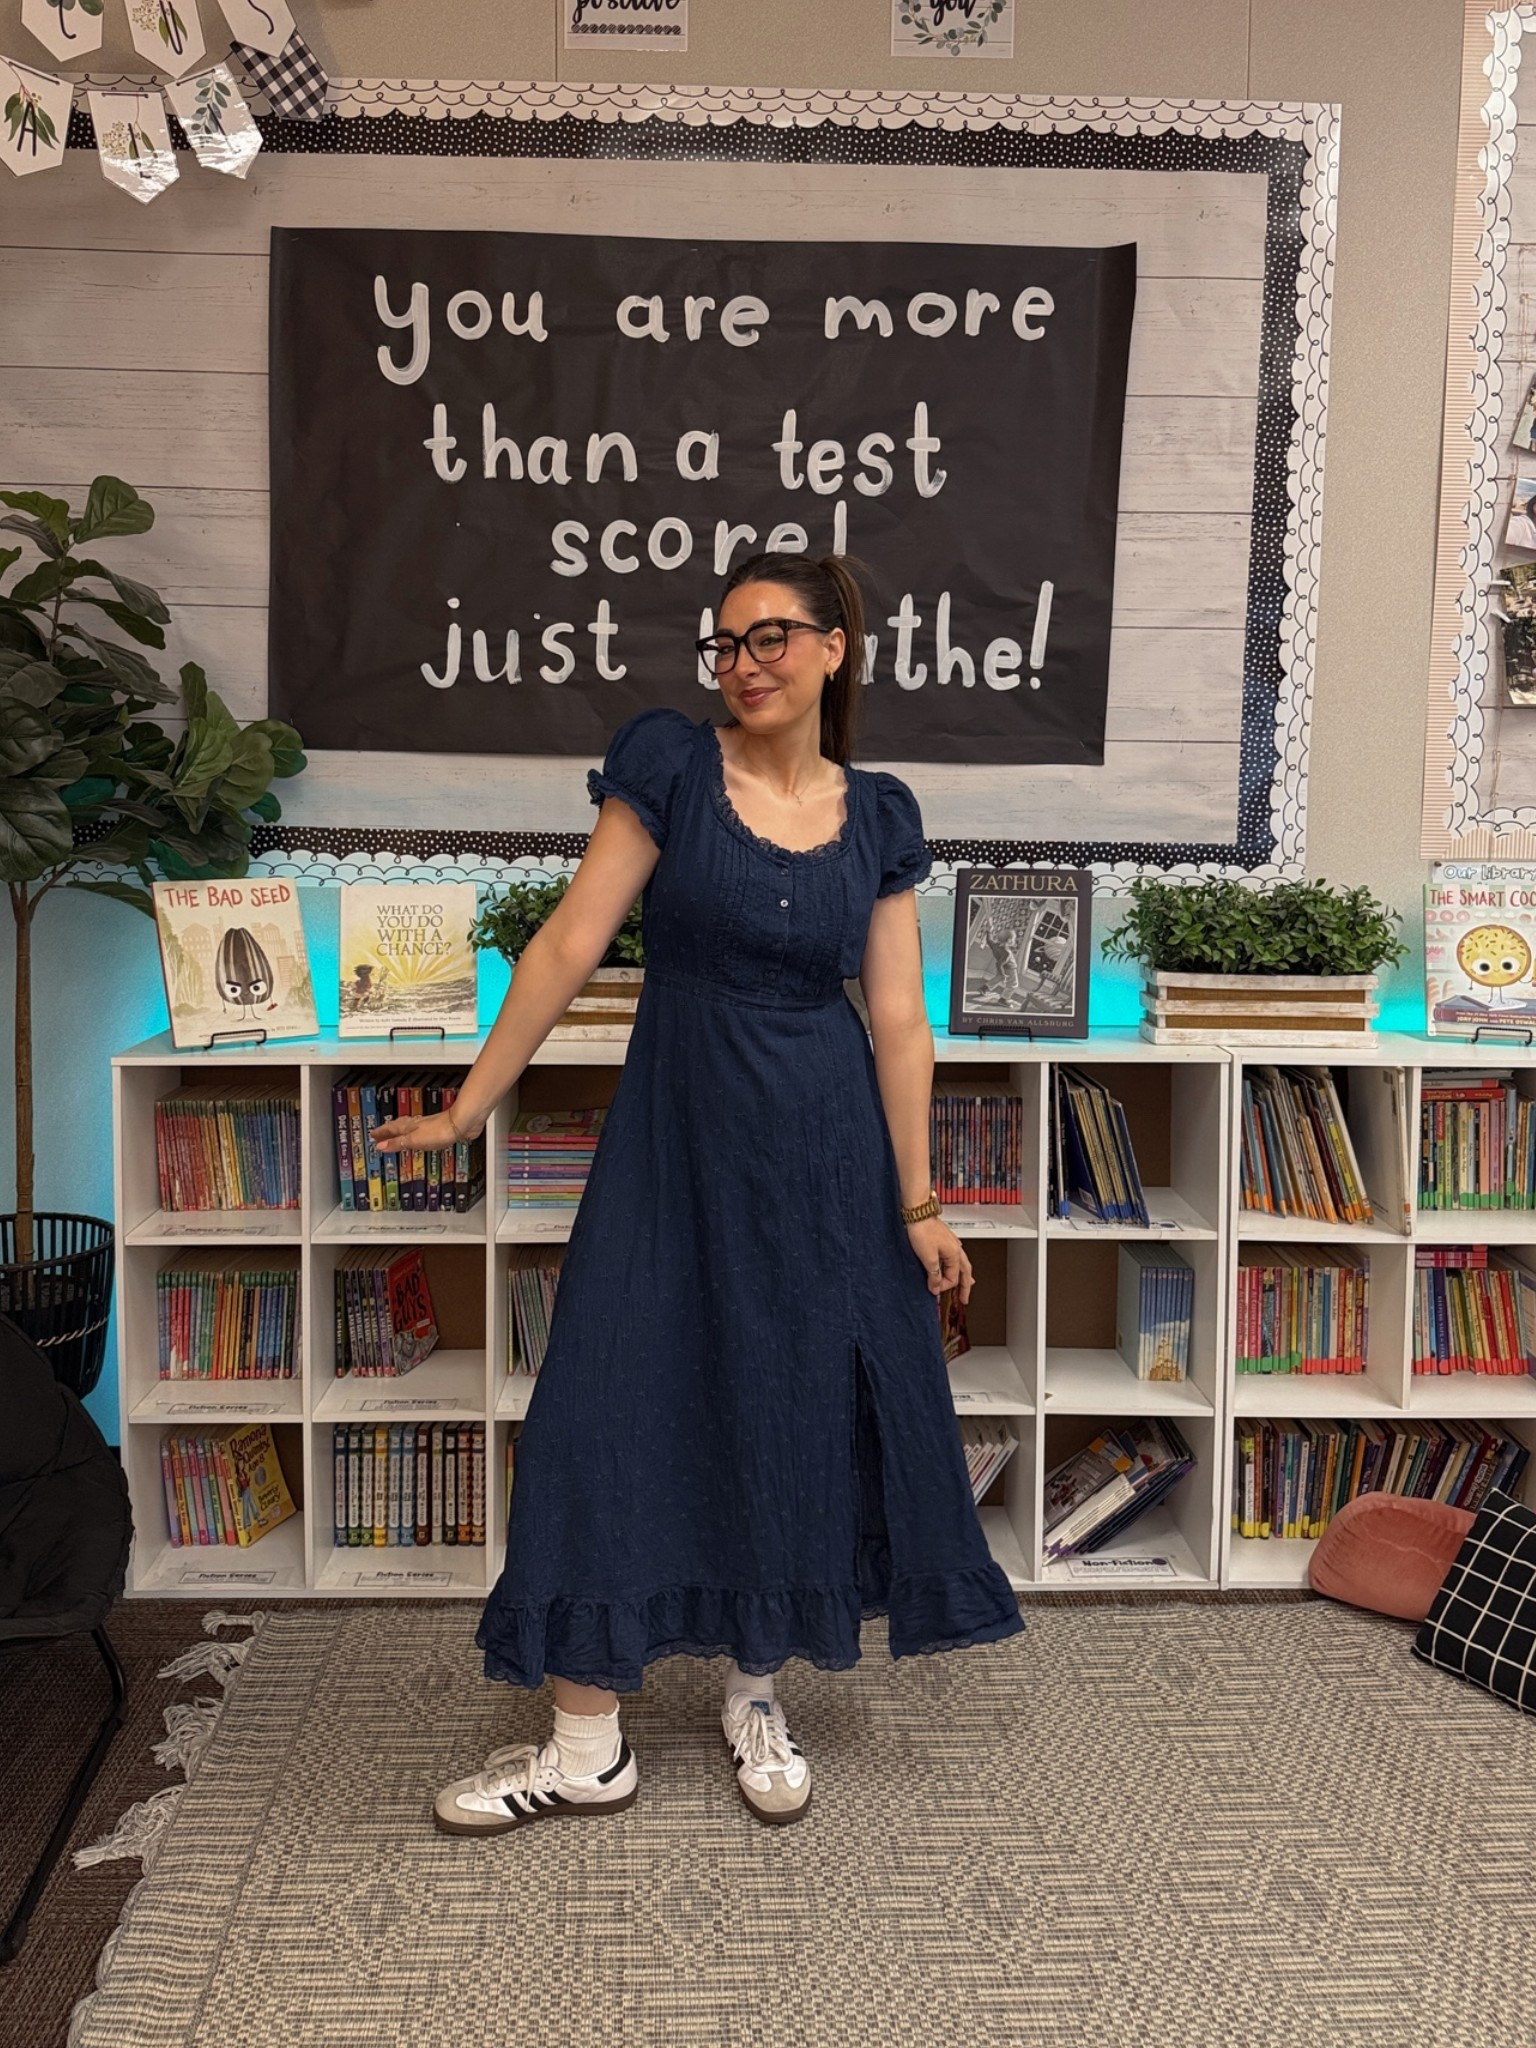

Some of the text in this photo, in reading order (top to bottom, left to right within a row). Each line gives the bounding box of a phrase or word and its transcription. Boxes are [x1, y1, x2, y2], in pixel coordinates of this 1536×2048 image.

[375, 276, 1054, 385] you are more
[423, 402, 947, 498] than a test
[421, 598, 626, 690] just
[1443, 865, 1477, 880] Our
[970, 874, 1079, 892] ZATHURA
[163, 884, 291, 908] THE BAD SEED
[1429, 889, 1454, 905] THE
[1459, 889, 1505, 907] SMART
[376, 904, 443, 915] WHAT DO
[376, 915, 444, 928] YOU DO
[377, 929, 443, 942] WITH A
[376, 942, 452, 956] CHANCE?
[393, 1271, 427, 1334] BAD GUYS
[230, 1424, 267, 1458] Ramona
